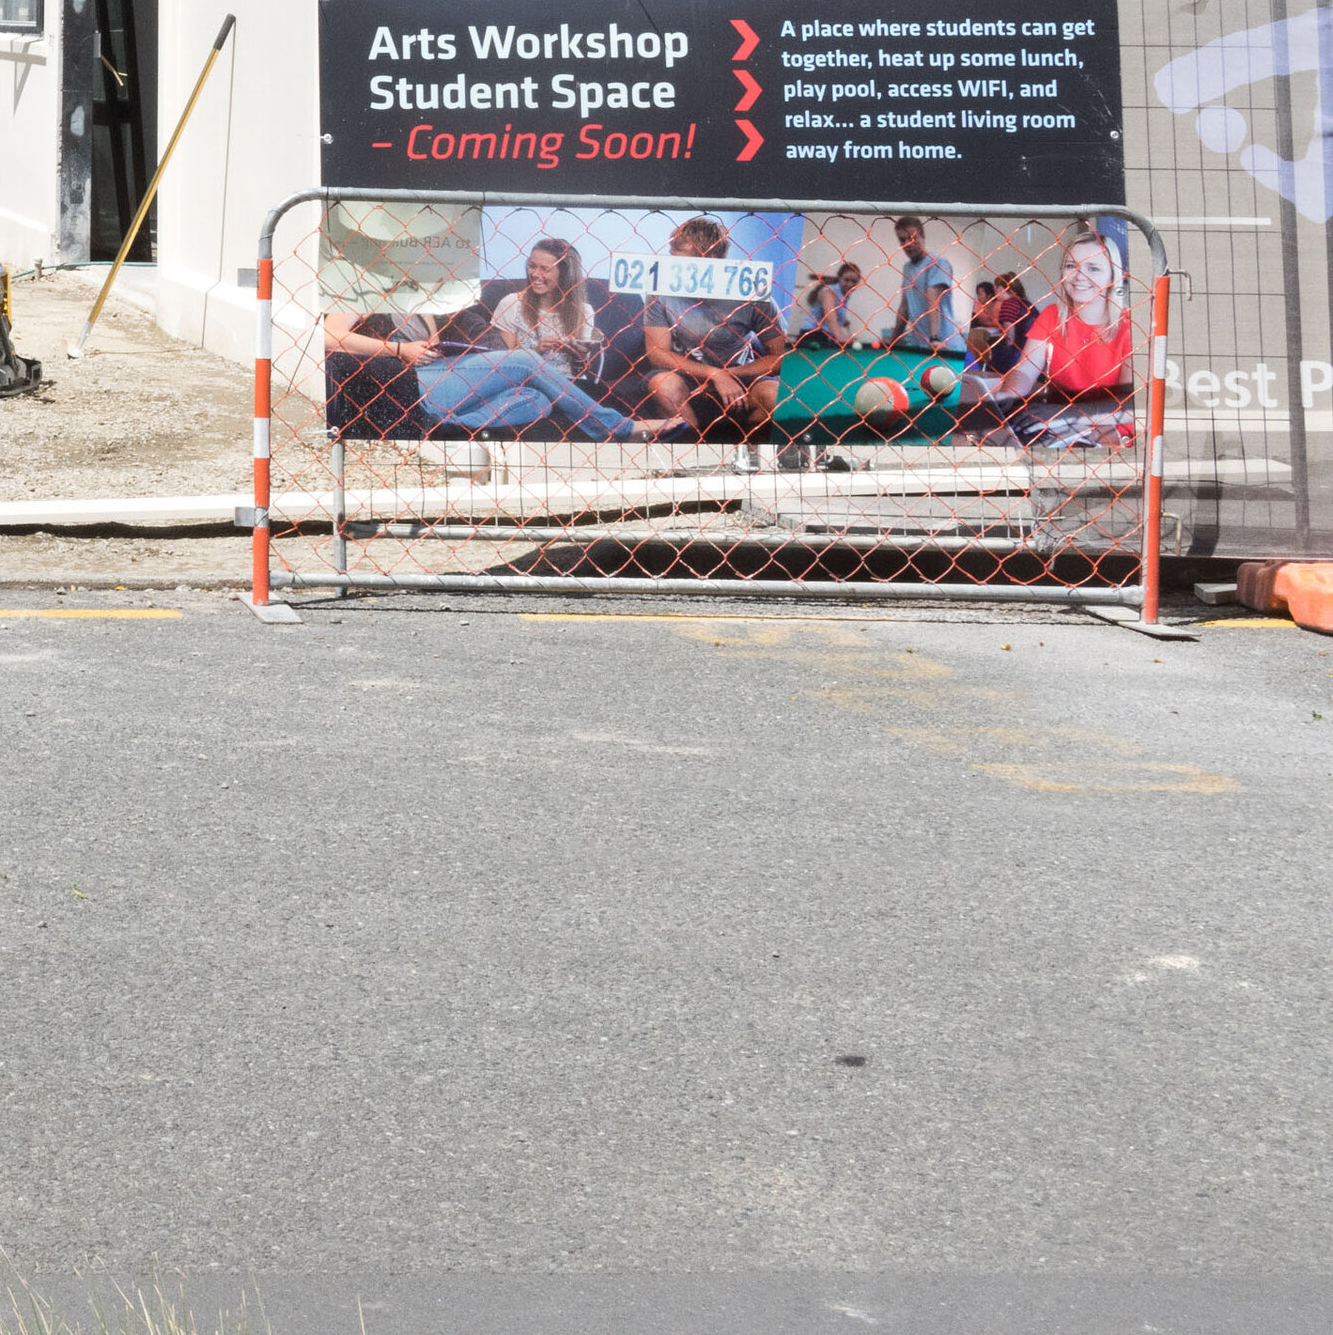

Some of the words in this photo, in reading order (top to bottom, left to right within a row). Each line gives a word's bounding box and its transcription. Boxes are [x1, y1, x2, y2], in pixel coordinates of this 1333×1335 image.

[781, 20, 796, 37] A
[802, 19, 854, 41] place
[858, 19, 922, 36] where
[926, 18, 1016, 36] students
[1022, 22, 1057, 36] can
[1062, 20, 1095, 40] get
[368, 26, 456, 60] Arts
[468, 23, 688, 67] Workshop
[781, 49, 872, 71] together,
[878, 49, 924, 66] heat
[929, 53, 955, 71] up
[961, 53, 1015, 66] some
[1021, 48, 1083, 69] lunch,
[369, 73, 539, 110] Student
[551, 74, 675, 118] Space
[784, 80, 824, 102] play
[832, 79, 882, 102] pool,
[888, 84, 953, 97] access
[958, 80, 1013, 100] WIFI,
[1020, 79, 1057, 97] and
[785, 110, 853, 128] relax...
[860, 115, 871, 128] a
[877, 110, 956, 128] student
[962, 110, 1017, 132] living
[1023, 115, 1075, 128] room
[407, 124, 564, 169] Coming
[575, 123, 696, 159] Soon!
[786, 145, 838, 163] away
[843, 140, 893, 159] from
[898, 140, 963, 159] home.
[614, 258, 661, 292] 021
[668, 262, 715, 294] 334
[723, 265, 769, 298] 766
